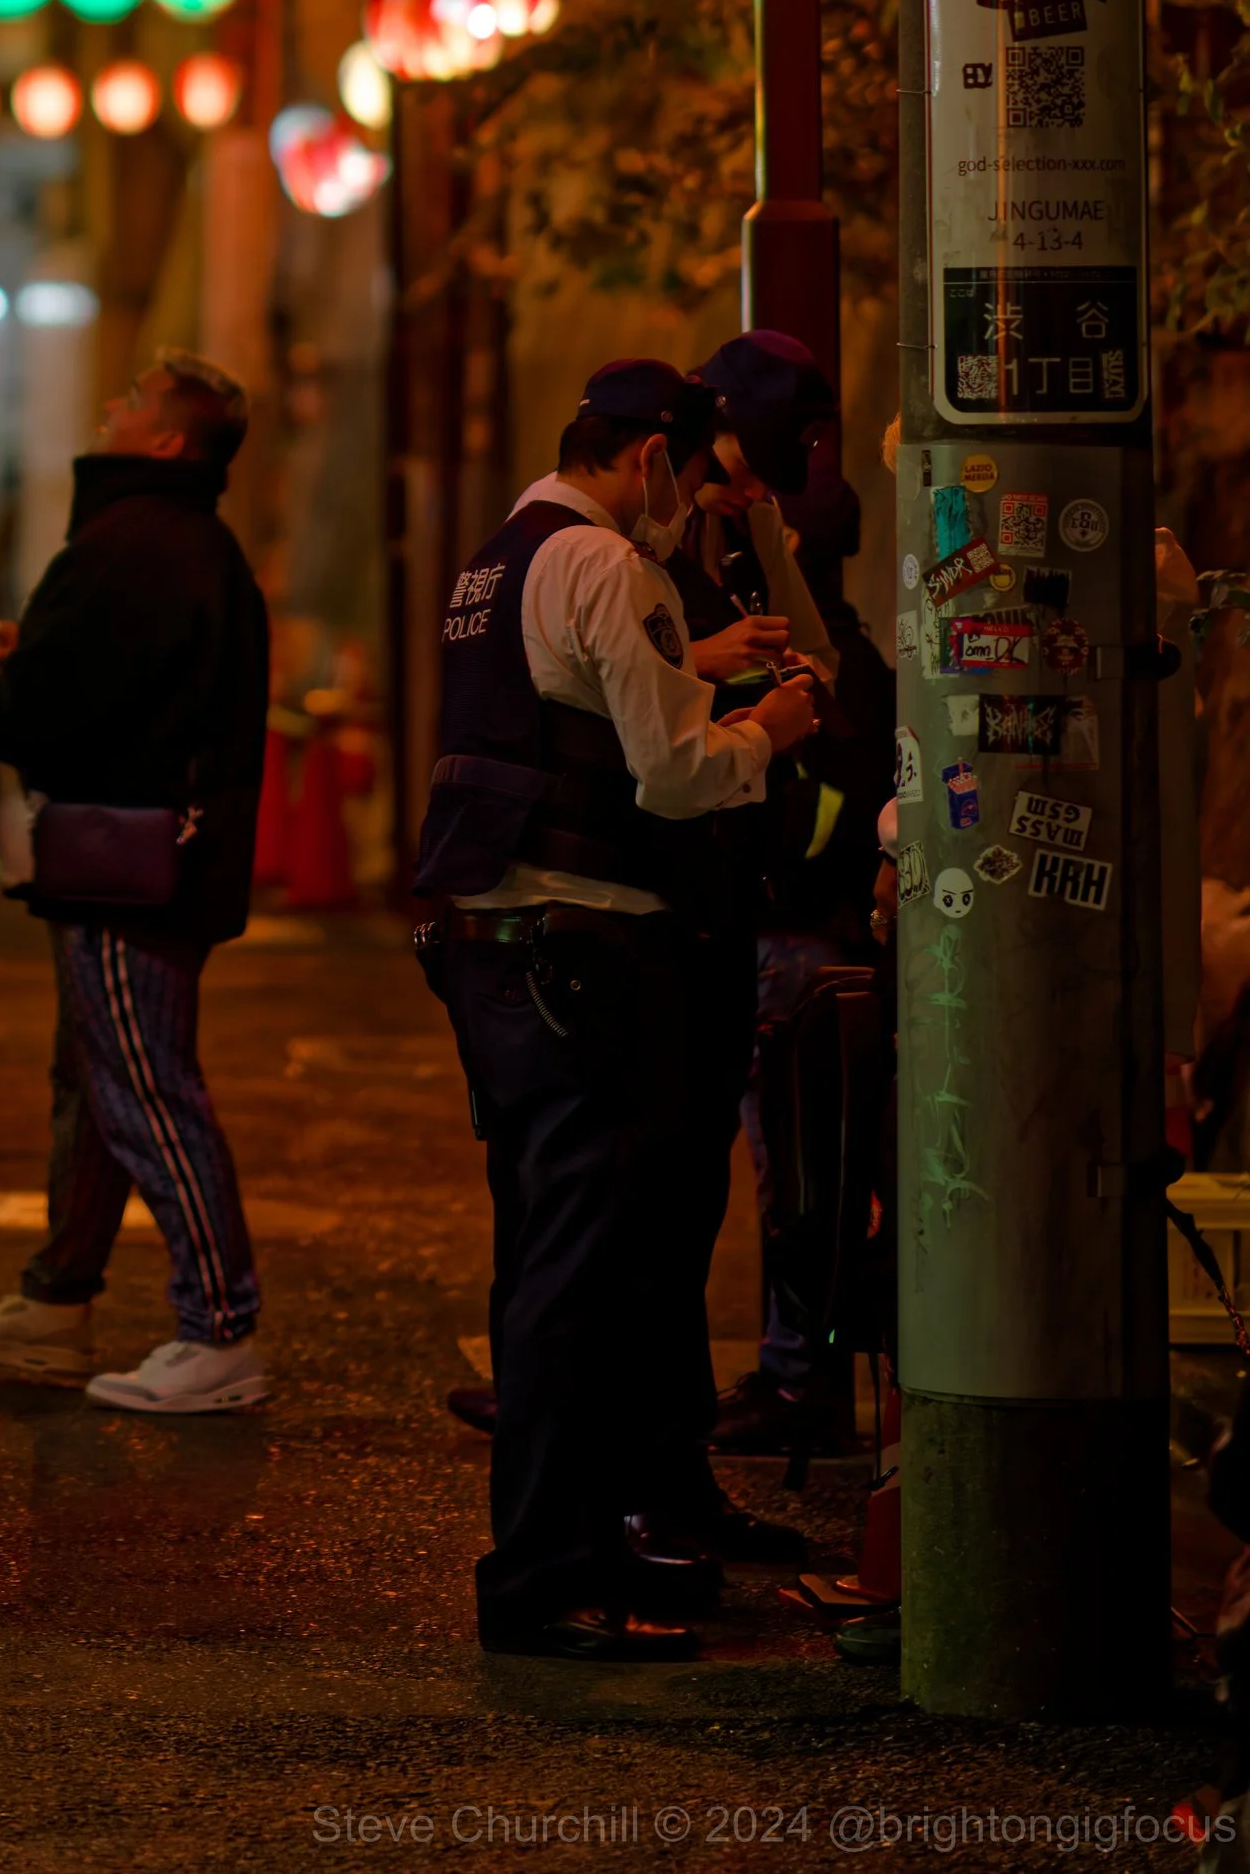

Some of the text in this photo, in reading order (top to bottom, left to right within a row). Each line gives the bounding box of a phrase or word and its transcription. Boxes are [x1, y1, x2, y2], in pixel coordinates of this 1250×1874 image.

[1029, 2, 1084, 27] BEER
[957, 155, 1126, 176] god-selection-xxx.com
[988, 200, 1105, 221] JINGUMAE
[1013, 231, 1083, 251] 4-13-4
[1004, 356, 1094, 396] 1丁目
[964, 464, 993, 473] LAZIO
[449, 561, 507, 609] 警視庁
[441, 608, 493, 644] POLICE
